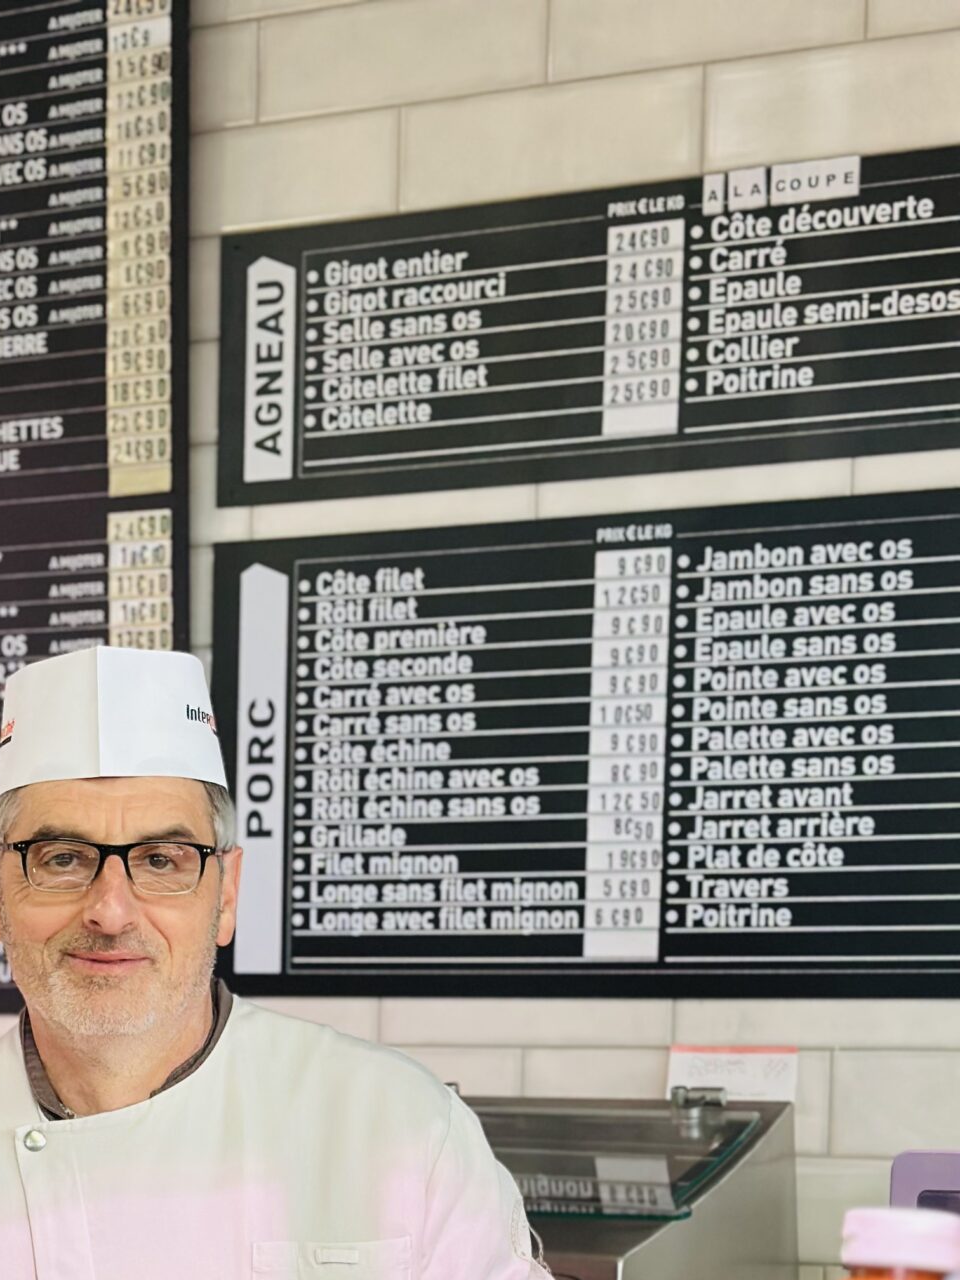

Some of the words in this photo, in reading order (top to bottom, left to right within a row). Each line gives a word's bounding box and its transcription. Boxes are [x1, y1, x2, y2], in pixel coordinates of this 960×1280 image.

[708, 190, 718, 201] A
[734, 184, 761, 198] LA
[775, 172, 854, 192] COUPE
[709, 207, 773, 244] Côte
[776, 188, 935, 236] découverte
[322, 254, 388, 293] Gigot
[391, 244, 469, 280] entier
[708, 238, 788, 274] Carré
[322, 284, 388, 321] Gigot
[391, 271, 507, 309] raccourci
[707, 268, 803, 309] Epaule
[321, 313, 386, 344] Selle
[388, 311, 448, 338] sans
[450, 307, 482, 331] os
[706, 299, 799, 339] Epaule
[321, 342, 385, 373] Selle
[387, 341, 445, 366] avec
[448, 337, 480, 361] os
[704, 329, 800, 365] Collier
[254, 280, 285, 456] AGNEAU
[320, 366, 433, 401] Côtelette
[435, 361, 488, 391] filet
[704, 359, 815, 395] Poitrine
[320, 395, 432, 429] Côtelette
[694, 541, 805, 572] Jambon
[808, 539, 874, 565] avec
[878, 537, 913, 560] os
[314, 569, 372, 595] Côte
[373, 567, 425, 591] filet
[693, 569, 804, 602] Jambon
[807, 570, 875, 595] sans
[879, 568, 914, 591] os
[314, 596, 364, 623] Rôti
[366, 593, 418, 620] filet
[694, 601, 788, 637] Epaule
[791, 602, 857, 627] avec
[860, 600, 896, 623] os
[313, 624, 370, 651] Côte
[372, 618, 487, 653] première
[693, 631, 787, 666] Epaule
[790, 633, 858, 657] sans
[861, 630, 897, 653] os
[312, 653, 369, 679] Côte
[371, 648, 474, 677] seconde
[692, 662, 780, 691] Pointe
[783, 664, 848, 687] avec
[852, 662, 887, 684] os
[311, 681, 382, 708] Carré
[384, 678, 442, 705] avec
[444, 682, 476, 702] os
[690, 692, 778, 721] Pointe
[782, 694, 849, 718] sans
[852, 692, 887, 715] os
[311, 709, 382, 736] Carré
[383, 712, 443, 733] sans
[445, 710, 477, 731] os
[690, 721, 788, 751] Palette
[790, 724, 856, 747] avec
[860, 722, 895, 745] os
[310, 738, 367, 764] Côte
[369, 735, 452, 762] échine
[247, 699, 276, 839] PORC
[310, 766, 360, 791] Rôti
[362, 764, 445, 790] échine
[446, 766, 505, 788] avec
[507, 765, 540, 786] os
[689, 751, 786, 781] Palette
[790, 754, 857, 777] sans
[861, 753, 896, 775] os
[310, 795, 360, 819] Rôti
[361, 792, 444, 818] échine
[446, 795, 507, 816] sans
[509, 794, 541, 815] os
[686, 782, 773, 810] Jarret
[776, 781, 854, 807] avant
[309, 822, 407, 847] Grillade
[685, 811, 772, 839] Jarret
[775, 809, 876, 837] arrière
[309, 850, 365, 875] Filet
[367, 849, 459, 879] mignon
[686, 842, 742, 868] Plat
[745, 841, 781, 867] de
[785, 840, 845, 867] côte
[308, 878, 379, 907] Longe
[380, 877, 436, 902] sans
[438, 877, 487, 901] filet
[489, 875, 579, 906] mignon
[684, 871, 790, 898] Travers
[308, 906, 379, 935] Longe
[380, 910, 435, 930] avec
[437, 905, 487, 929] filet
[489, 904, 580, 934] mignon
[684, 900, 793, 927] Poitrine
